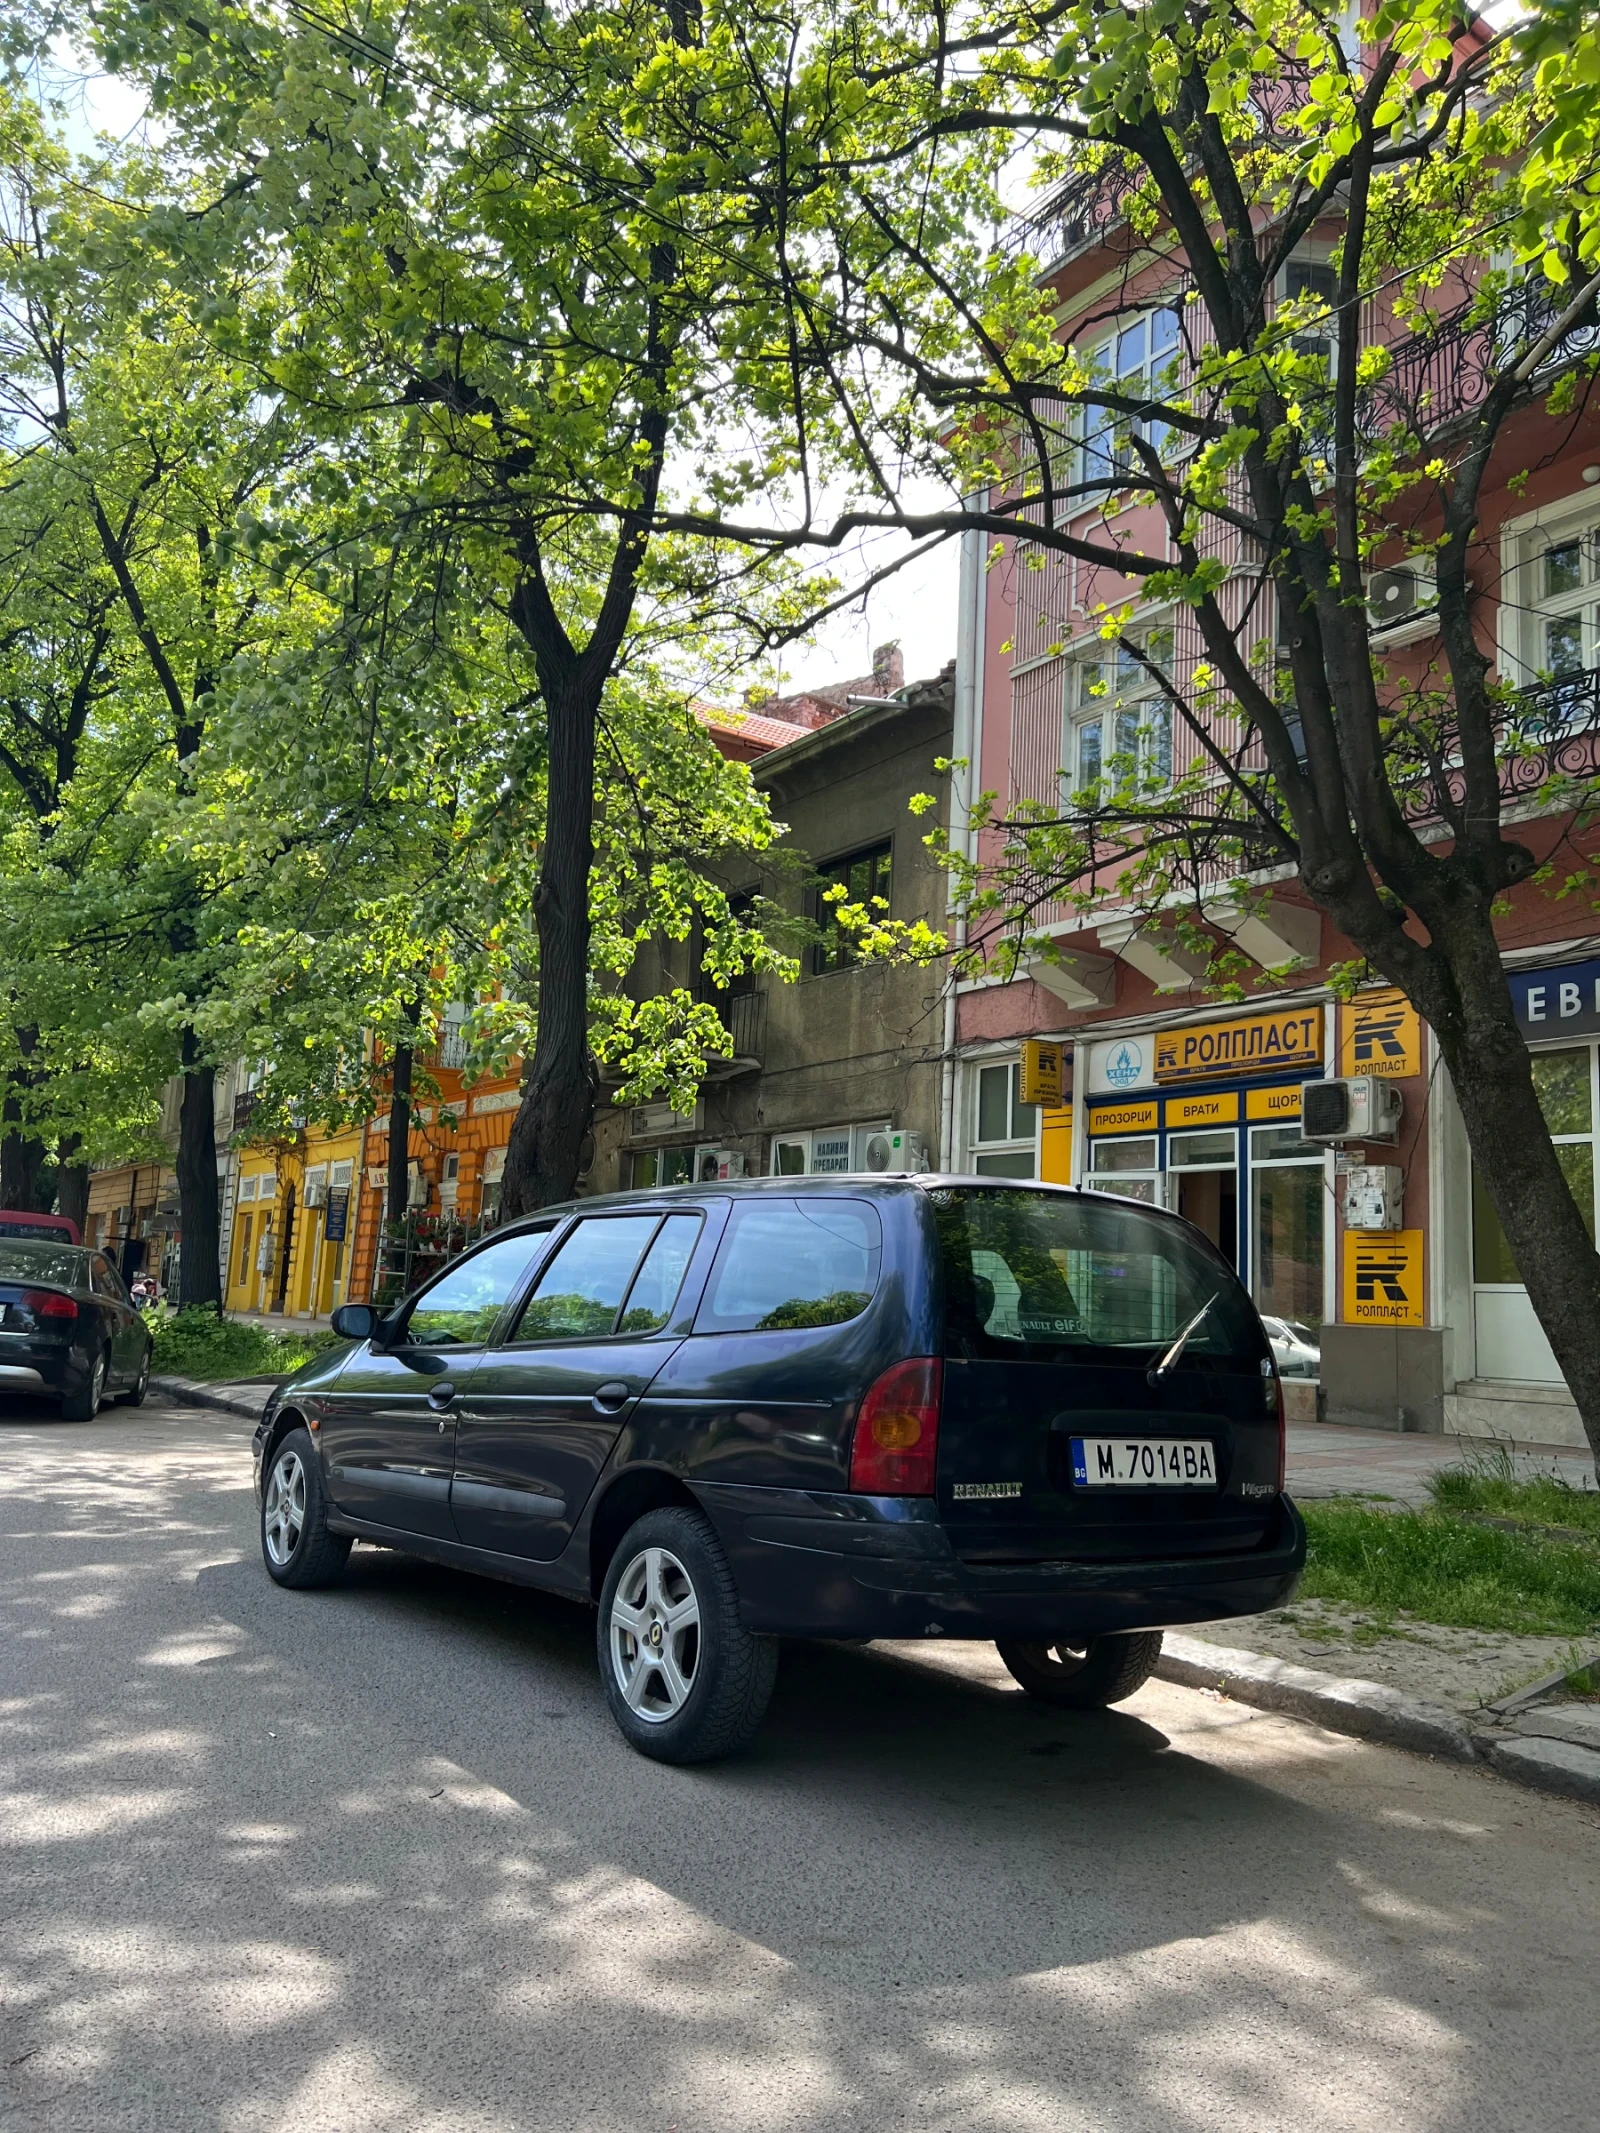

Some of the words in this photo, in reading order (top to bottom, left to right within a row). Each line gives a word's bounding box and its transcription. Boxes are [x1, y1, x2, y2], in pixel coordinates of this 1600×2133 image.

[1184, 1018, 1315, 1065] РОЛПЛАСТ
[1108, 1068, 1138, 1078] ХЕНА
[1354, 1059, 1407, 1076] РОЛПЛАСТ
[1183, 1103, 1219, 1117] ВРАТИ
[1095, 1110, 1152, 1126] ПРОЗОРЦИ
[1356, 1305, 1409, 1318] РОЛПЛАСТ
[1054, 1319, 1075, 1331] elf
[1074, 1467, 1086, 1478] BG
[952, 1482, 1023, 1500] RENAULT
